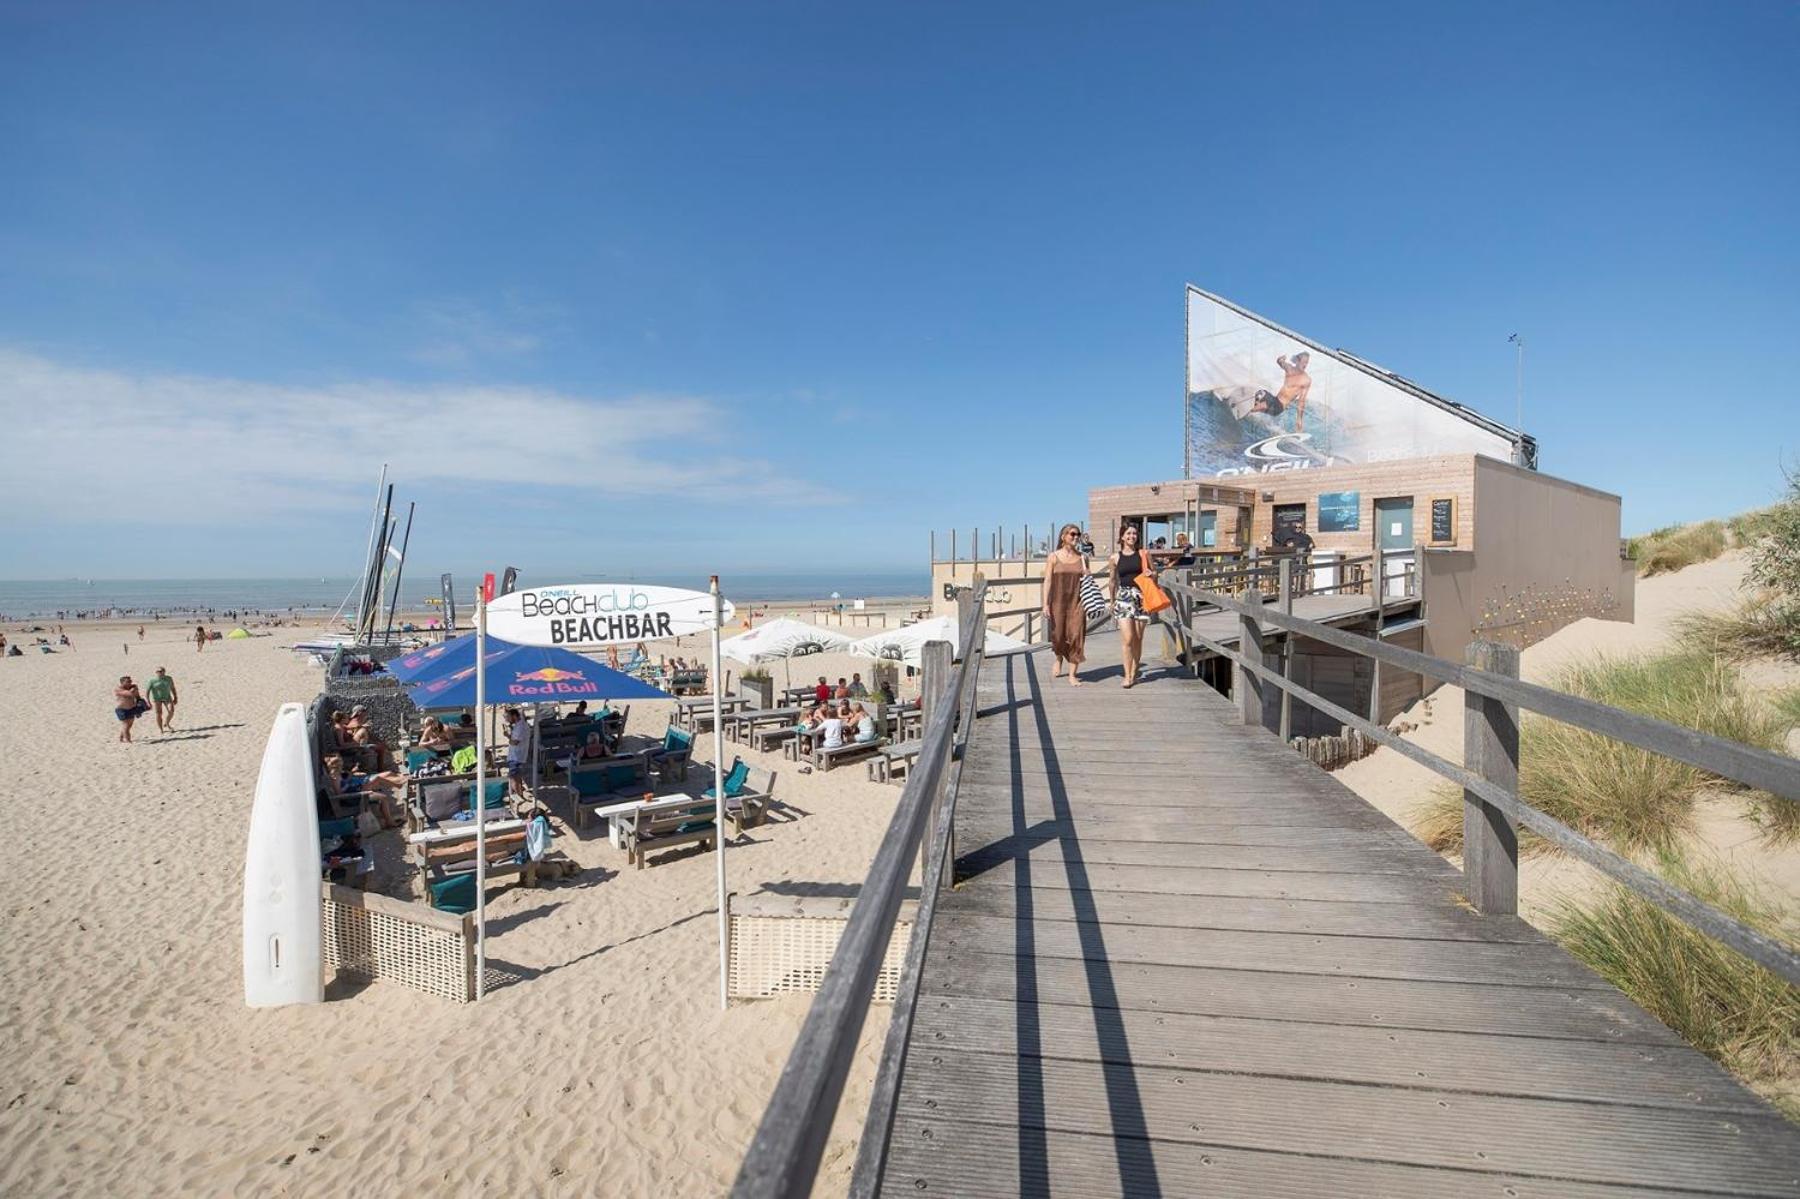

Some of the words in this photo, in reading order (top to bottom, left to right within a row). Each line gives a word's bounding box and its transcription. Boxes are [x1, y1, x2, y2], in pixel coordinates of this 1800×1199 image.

[550, 611, 674, 644] BEACHBAR
[508, 682, 555, 696] Red
[556, 681, 599, 694] Bull
